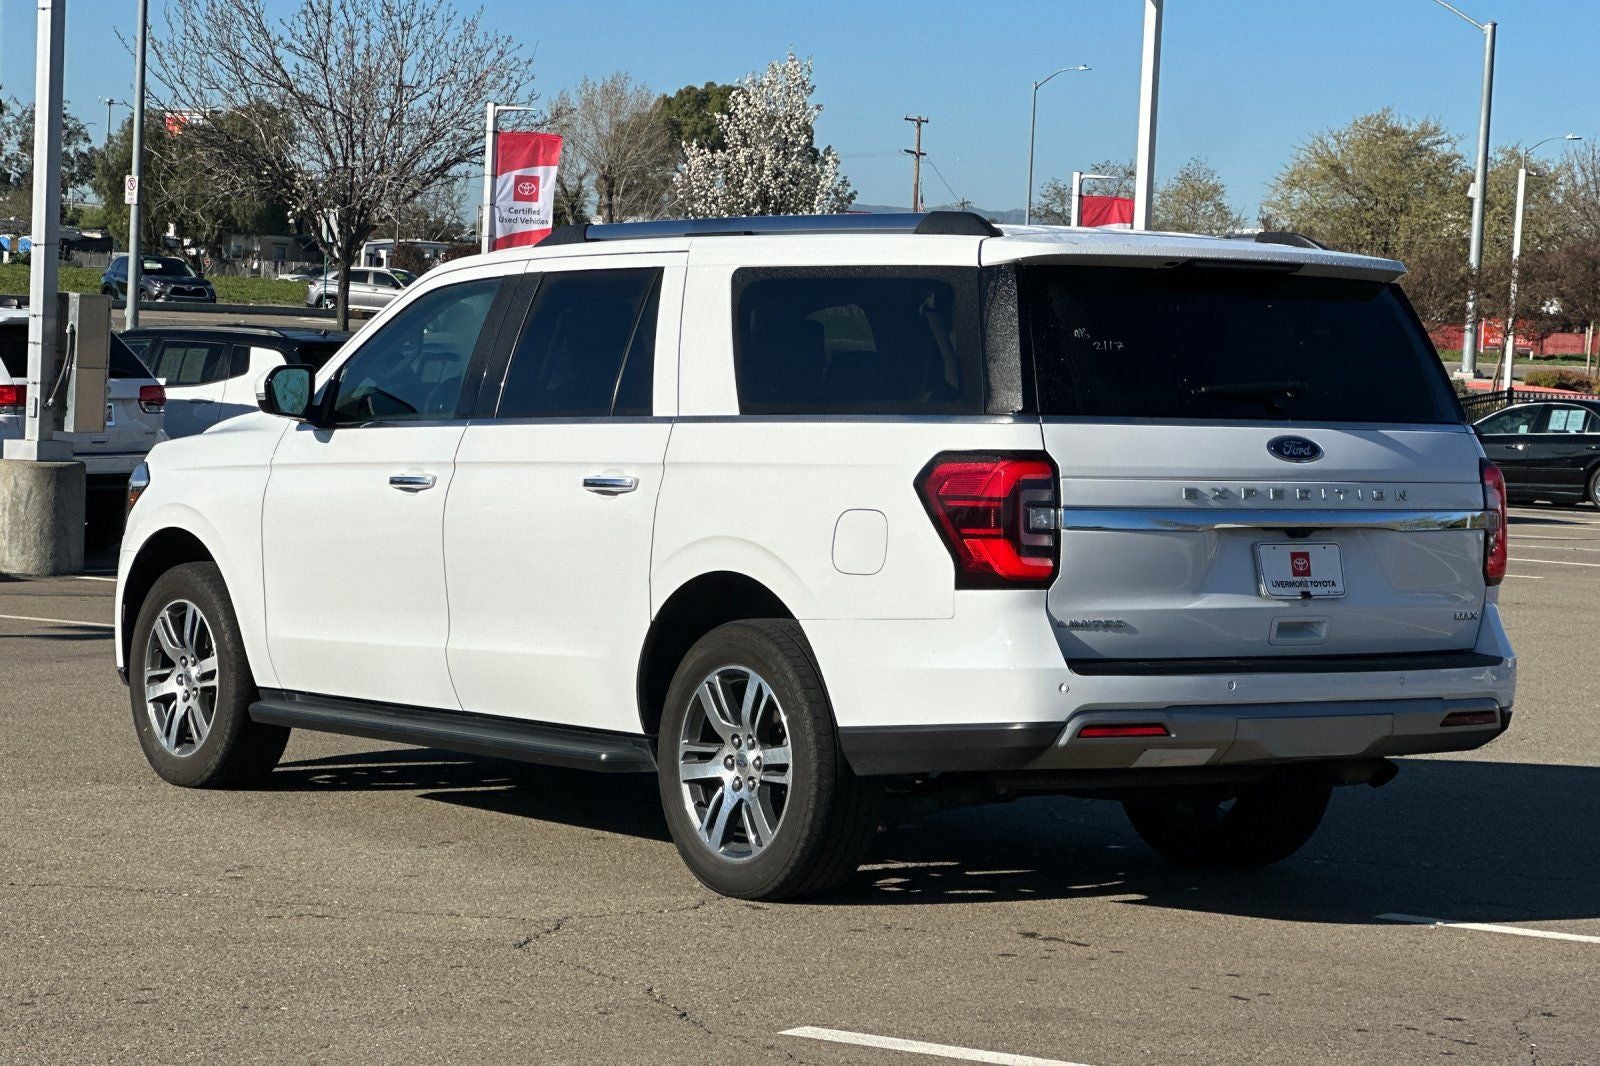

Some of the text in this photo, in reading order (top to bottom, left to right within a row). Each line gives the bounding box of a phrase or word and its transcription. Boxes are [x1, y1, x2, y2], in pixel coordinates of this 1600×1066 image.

[508, 207, 541, 215] Certified
[498, 216, 549, 225] Used Vehicles
[1283, 440, 1312, 456] Ford
[1182, 486, 1408, 501] EXPEDITION
[1271, 580, 1337, 588] LIVERMORE TOYOTA
[1454, 611, 1479, 621] MAX
